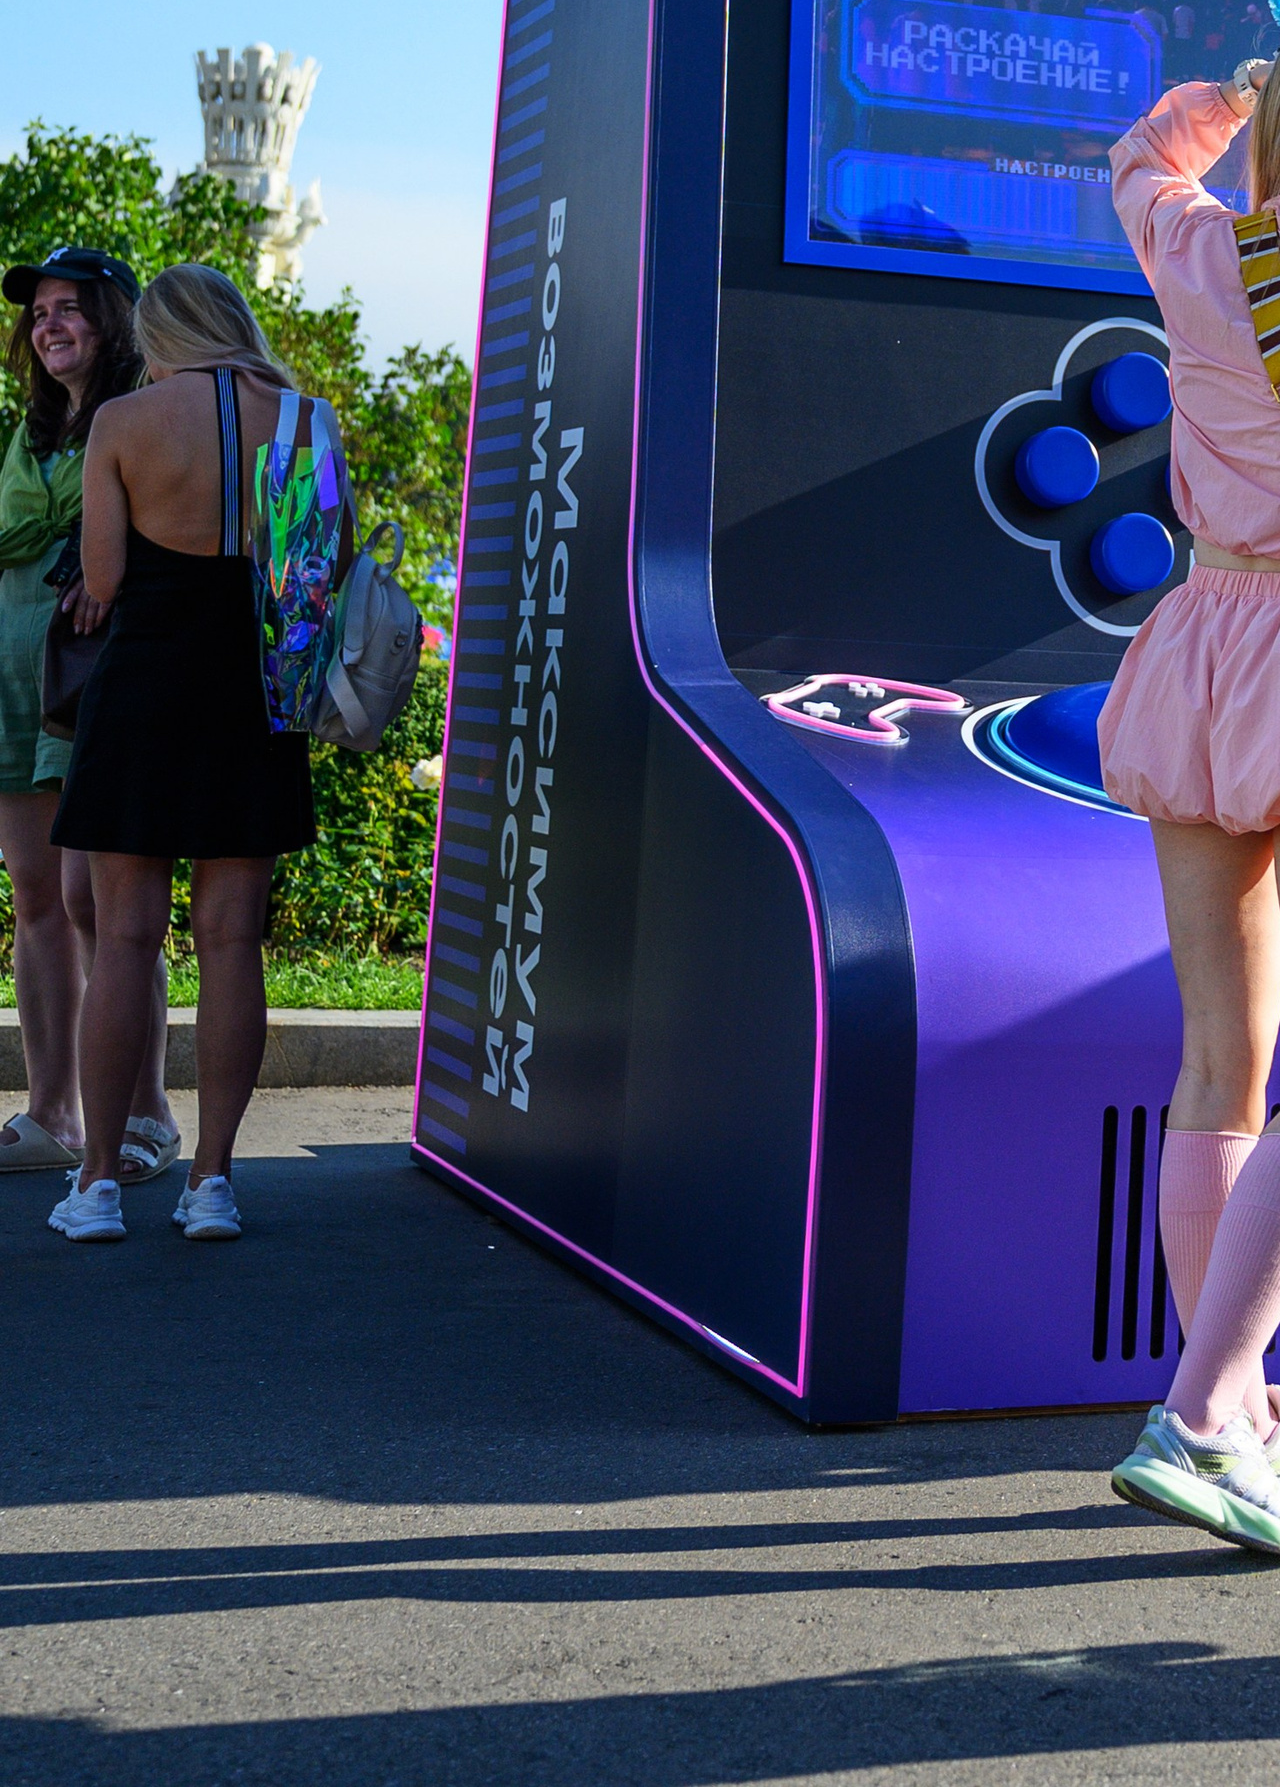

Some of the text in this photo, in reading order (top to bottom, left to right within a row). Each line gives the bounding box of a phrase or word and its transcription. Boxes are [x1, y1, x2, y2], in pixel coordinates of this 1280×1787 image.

[865, 41, 1131, 95] НАСТРОЕНИЕ!
[903, 19, 1100, 67] РАСКАЧАЙ
[994, 157, 1112, 184] НАСТРОЕН
[479, 195, 569, 1099] возможностей
[509, 426, 586, 1113] Максимум
